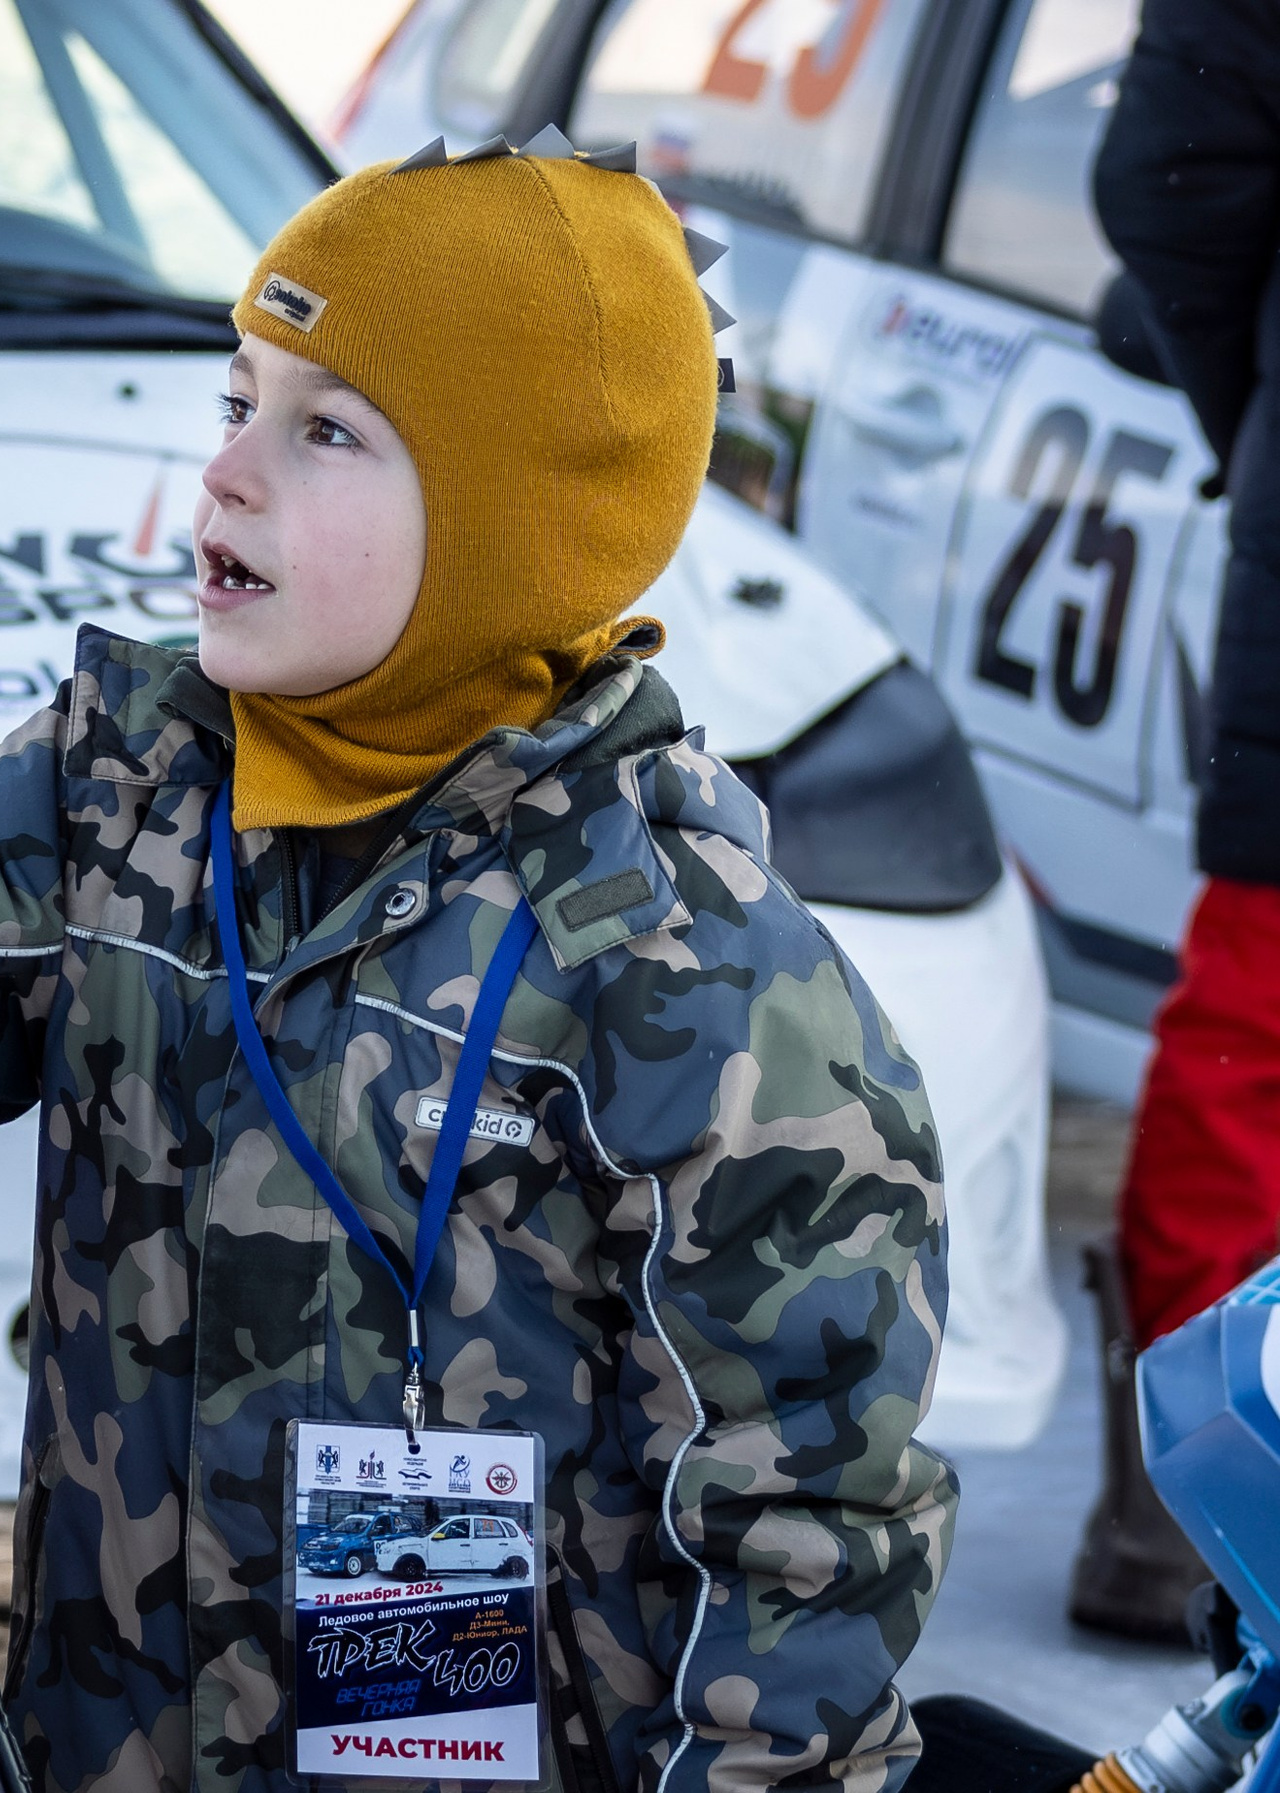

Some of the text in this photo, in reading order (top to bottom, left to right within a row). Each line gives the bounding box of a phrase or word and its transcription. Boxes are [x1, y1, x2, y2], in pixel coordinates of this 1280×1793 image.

[974, 404, 1177, 729] 25
[428, 1108, 503, 1135] ckid
[315, 1581, 444, 1606] 21 декабря 2024
[318, 1593, 509, 1628] Ледовое автомобильное шоу
[502, 1625, 528, 1635] ЛАДА
[307, 1619, 436, 1679] ТРЕК
[433, 1642, 520, 1697] 400
[336, 1679, 420, 1704] ВЕЧЕРНЯЯ
[361, 1696, 416, 1717] ГОНКА
[330, 1734, 505, 1762] УЧАСТНИК
